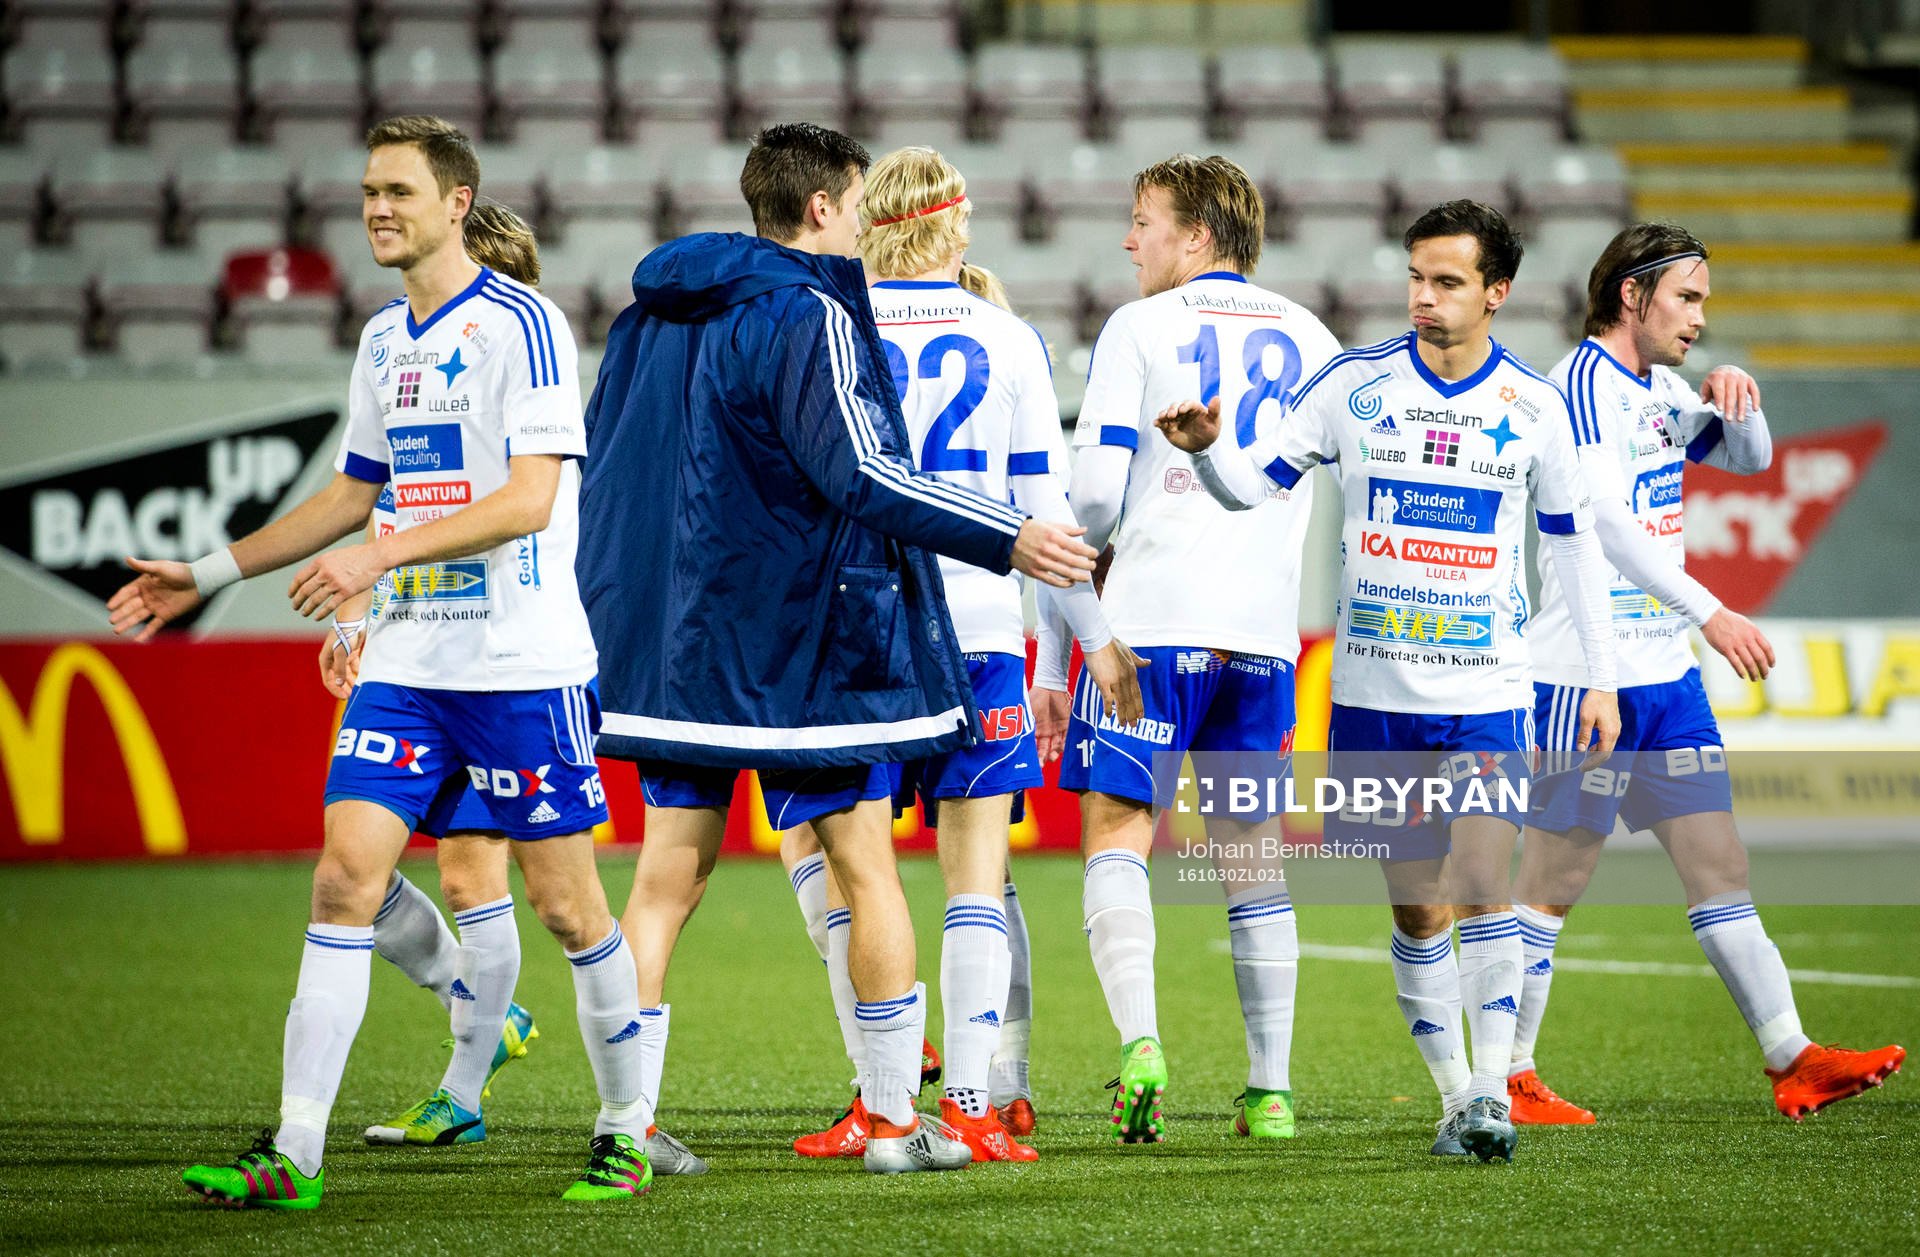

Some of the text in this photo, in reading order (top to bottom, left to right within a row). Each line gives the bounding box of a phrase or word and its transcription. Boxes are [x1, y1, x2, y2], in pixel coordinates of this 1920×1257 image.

[874, 304, 972, 320] karJouren
[1176, 324, 1302, 450] 18
[1404, 406, 1483, 429] stadium
[1370, 426, 1401, 437] adidas
[1370, 447, 1406, 463] LULEBO
[29, 434, 303, 570] BACK UP
[1402, 489, 1465, 511] Student
[1401, 505, 1477, 530] Consulting
[1361, 531, 1493, 566] ICA KVANTUM
[1357, 577, 1492, 607] Handelsbanken
[420, 609, 439, 621] och
[441, 607, 491, 621] Kontor
[1378, 607, 1462, 642] NKV
[1346, 641, 1501, 667] För Företag och Kontor
[1230, 660, 1272, 677] ESEBYRÅ
[334, 728, 431, 775] BDX
[1665, 745, 1727, 777] BD
[467, 764, 557, 798] BDX
[1580, 767, 1632, 798] BD
[527, 810, 561, 824] adidas
[905, 1145, 936, 1167] adidas
